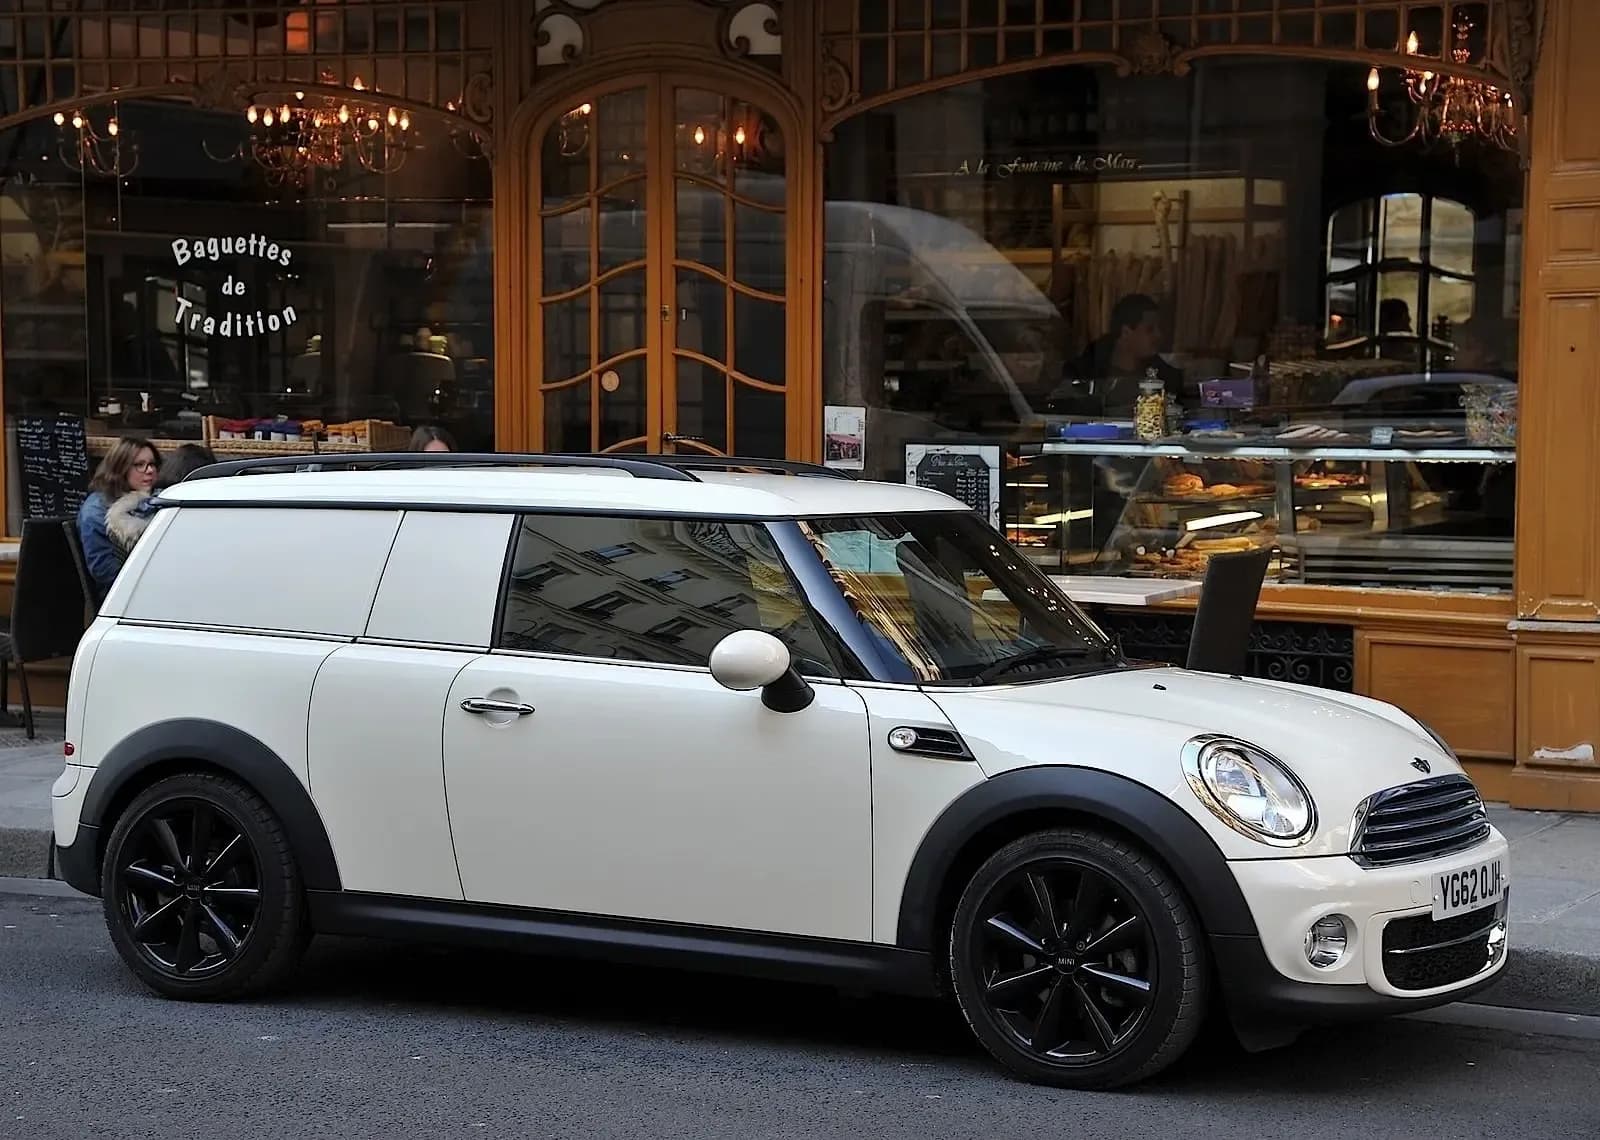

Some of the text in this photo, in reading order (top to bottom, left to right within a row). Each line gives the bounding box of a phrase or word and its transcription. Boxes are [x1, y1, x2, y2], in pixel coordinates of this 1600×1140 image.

[171, 233, 292, 266] Baguettes
[222, 275, 245, 295] de
[175, 296, 297, 338] Tradition
[1440, 868, 1478, 911] YG62
